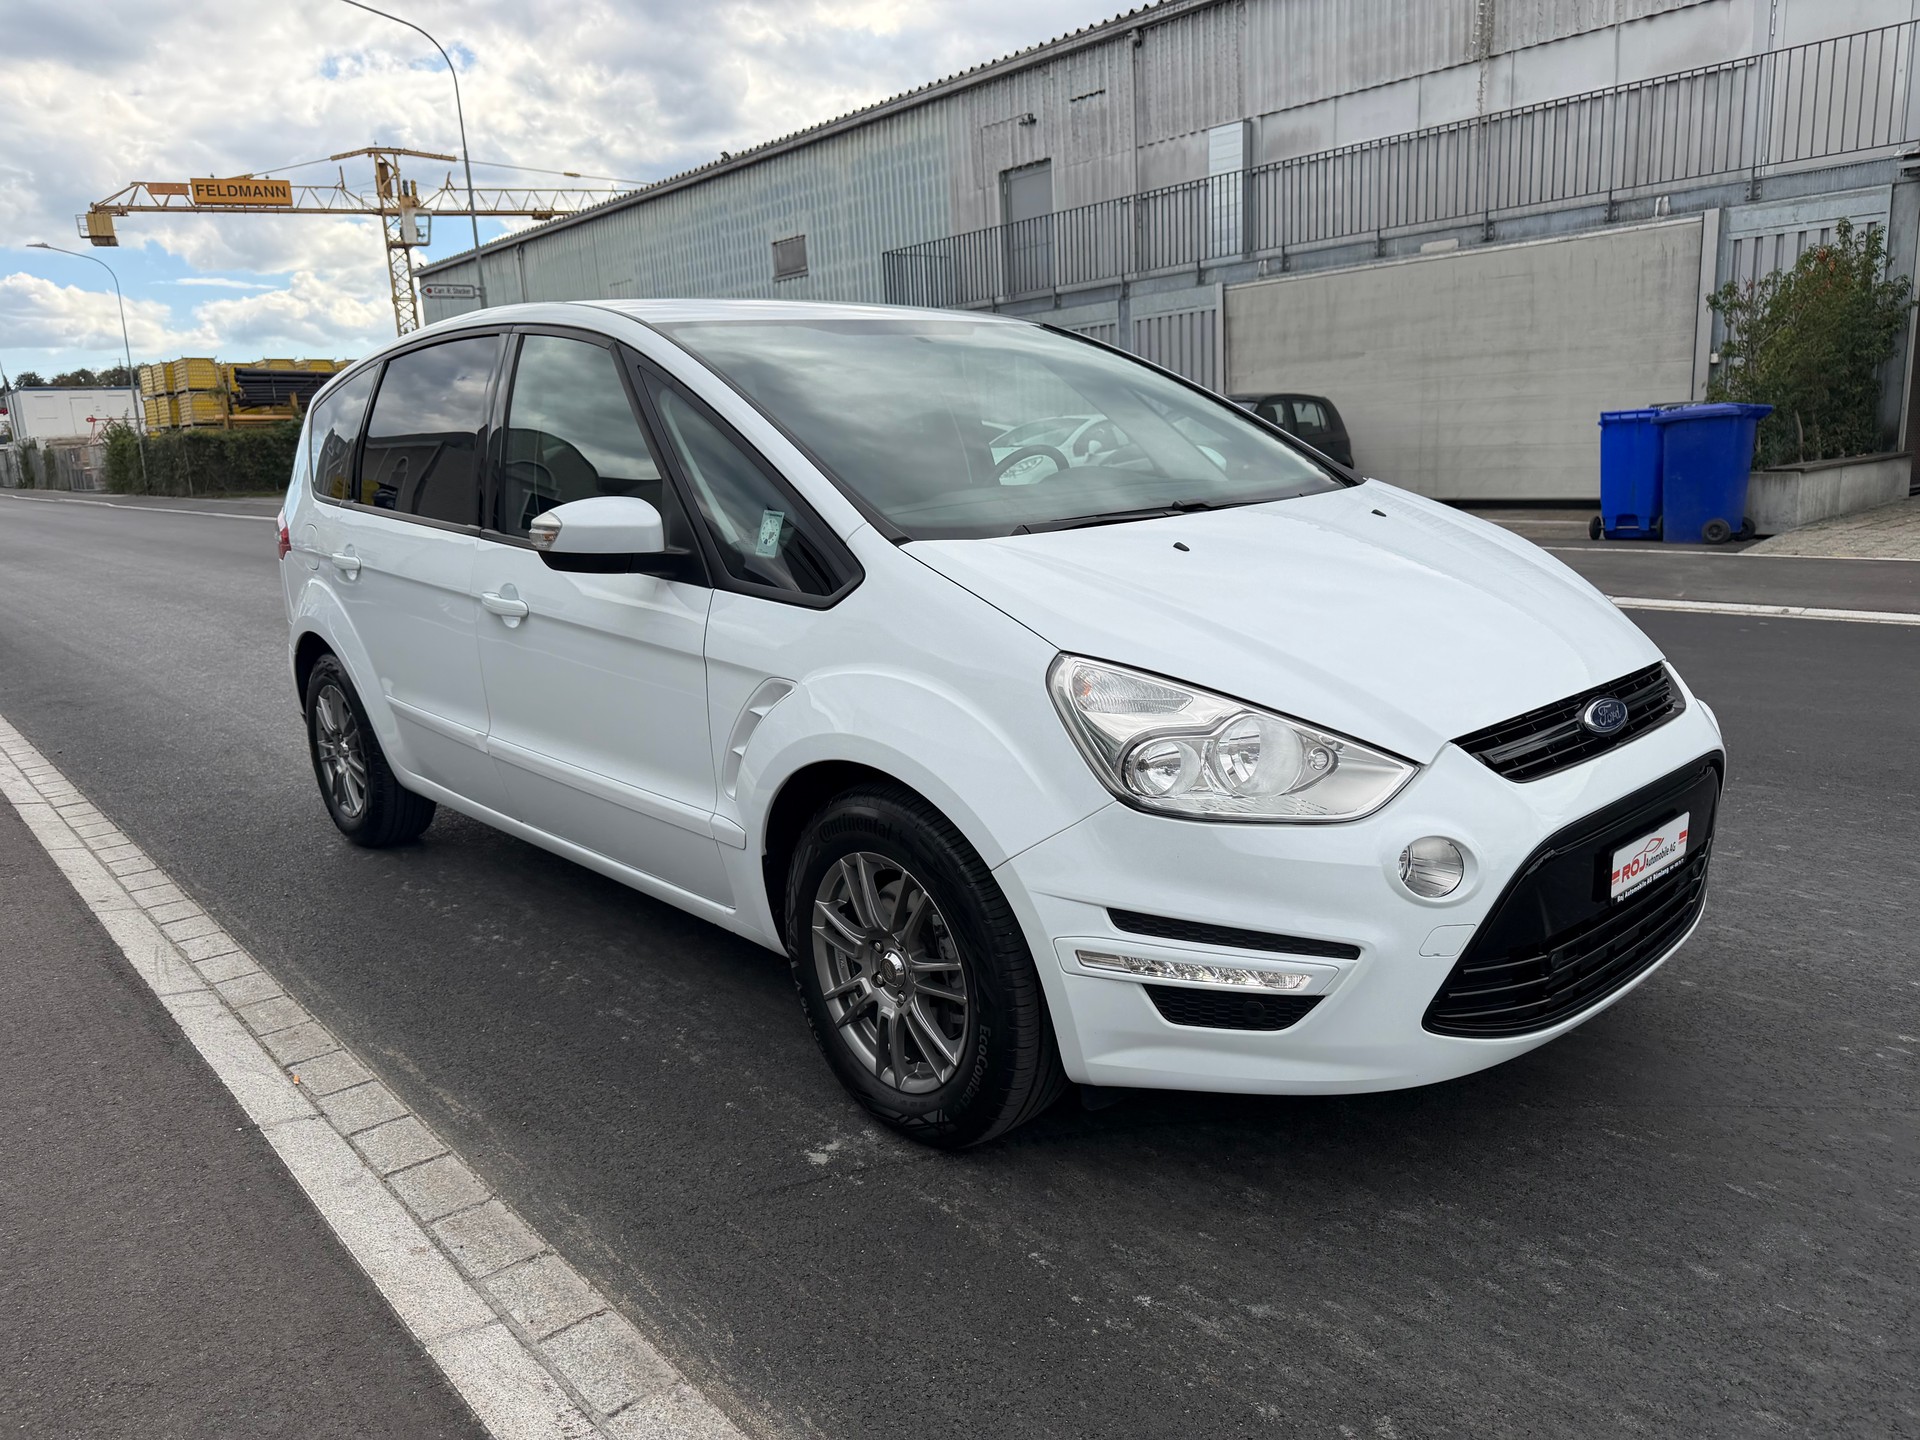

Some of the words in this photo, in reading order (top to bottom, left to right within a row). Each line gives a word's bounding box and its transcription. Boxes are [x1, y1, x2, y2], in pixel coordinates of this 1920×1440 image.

[195, 184, 287, 198] FELDMANN
[1597, 703, 1621, 726] Ford
[818, 812, 893, 843] Continental
[1646, 846, 1669, 868] Automobile
[1669, 841, 1676, 855] AG
[1624, 881, 1647, 898] Automobile
[1646, 876, 1653, 885] AG
